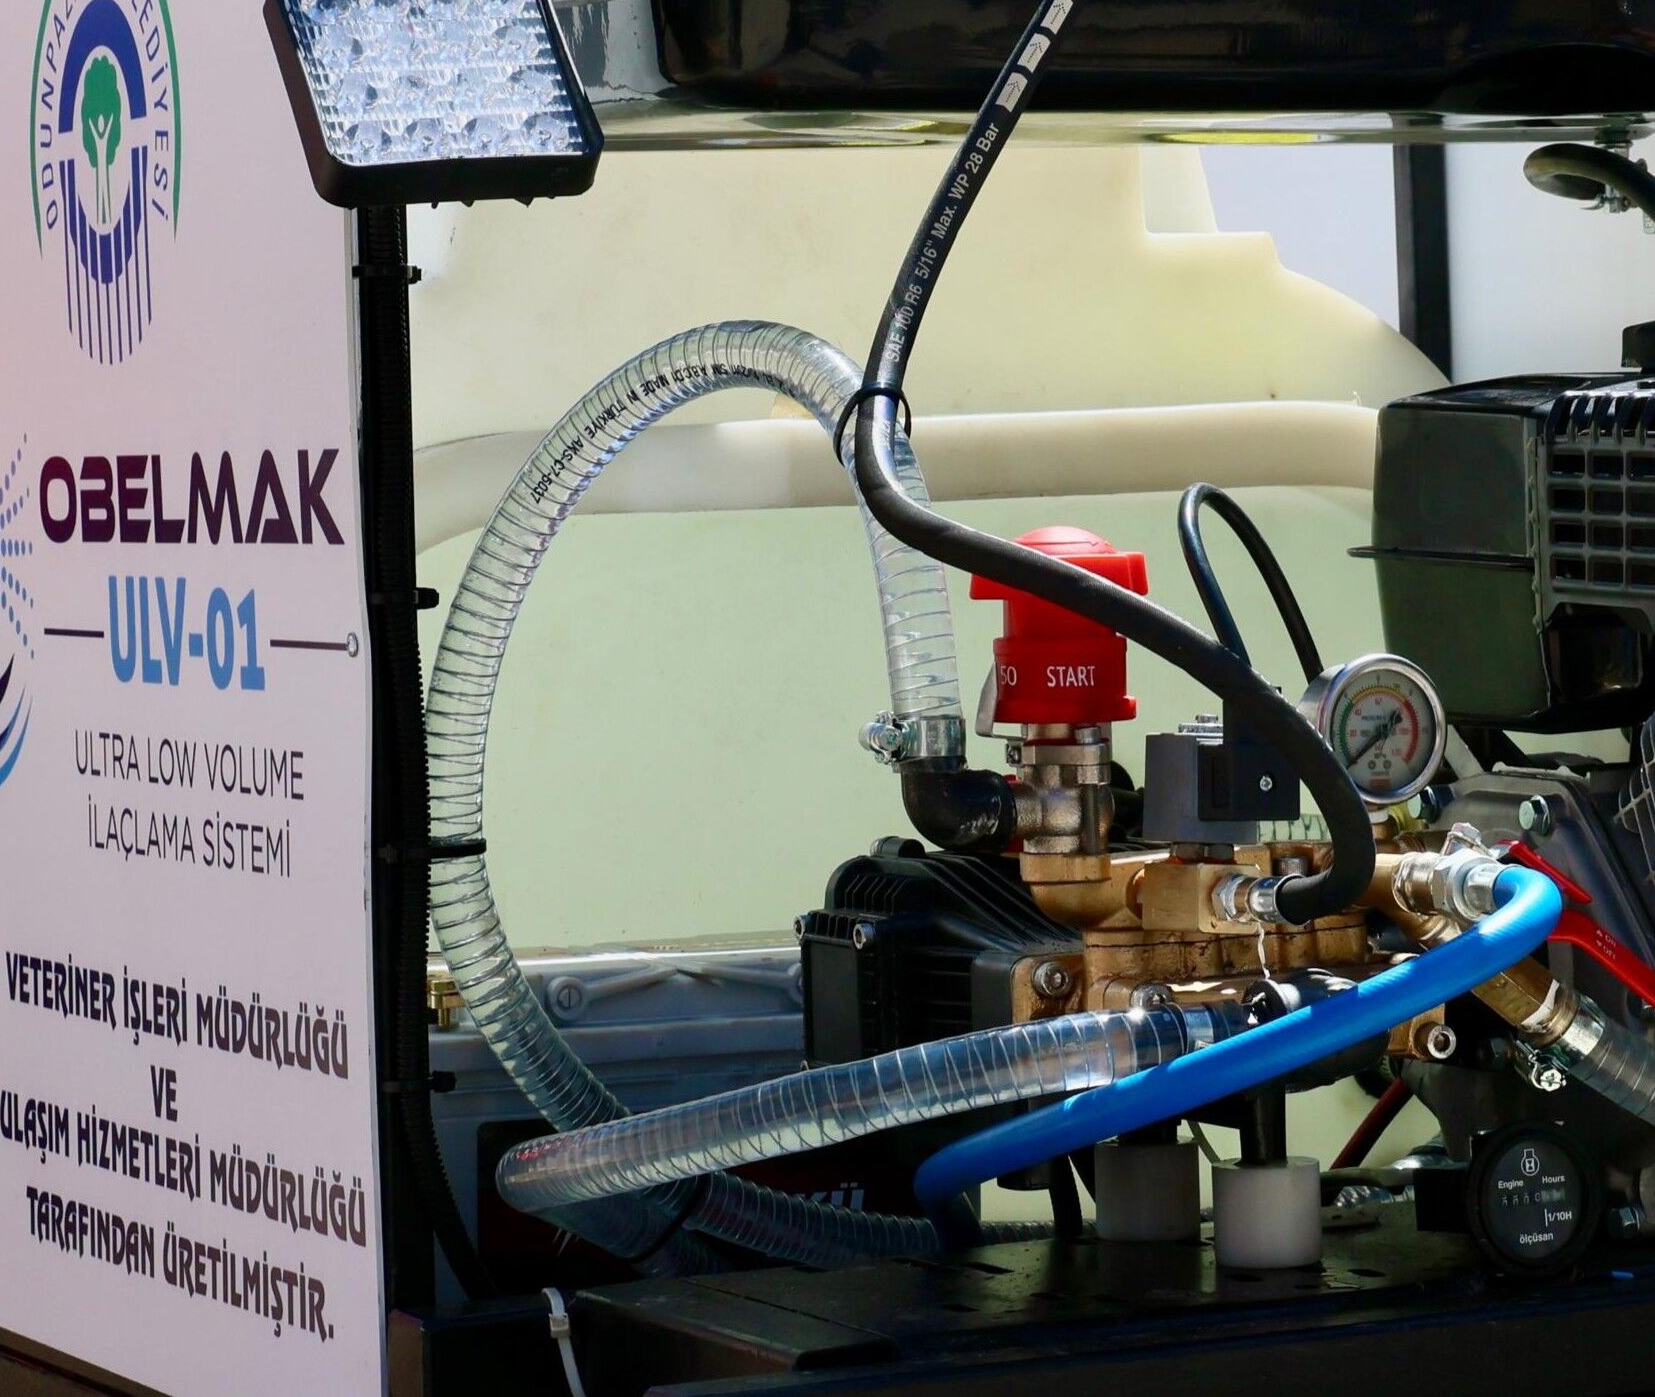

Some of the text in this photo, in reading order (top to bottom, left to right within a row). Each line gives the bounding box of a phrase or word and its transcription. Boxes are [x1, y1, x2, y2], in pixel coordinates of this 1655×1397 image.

[885, 331, 906, 363] SAE
[904, 283, 923, 306] R6
[914, 240, 938, 279] 5/16"
[930, 205, 958, 239] Max.
[947, 173, 970, 200] WP
[965, 152, 984, 174] 28
[975, 122, 1000, 152] Bar
[626, 389, 640, 404] IN
[639, 374, 670, 397] MADE
[39, 448, 346, 547] OBELMAK
[108, 575, 266, 691] ULV-01
[1046, 665, 1096, 687] START
[75, 729, 305, 801] ULTRA LOW VOLUME
[88, 793, 291, 878] İLAÇLAMA SİSTEMİ
[4, 951, 349, 1080] VETERİNER İŞLERİ MÜDÜRLÜĞÜ
[150, 1064, 178, 1123] VE
[0, 1090, 367, 1248] ULAŞIM HİZMETLERİ MÜDÜRLÜĞÜ
[1497, 1174, 1565, 1190] Engine Hours
[1519, 1231, 1554, 1245] ölçüsan
[1547, 1210, 1573, 1223] 1/10H
[26, 1185, 334, 1343] TARAFINDAN ÜRETİLMİŞTİR.
